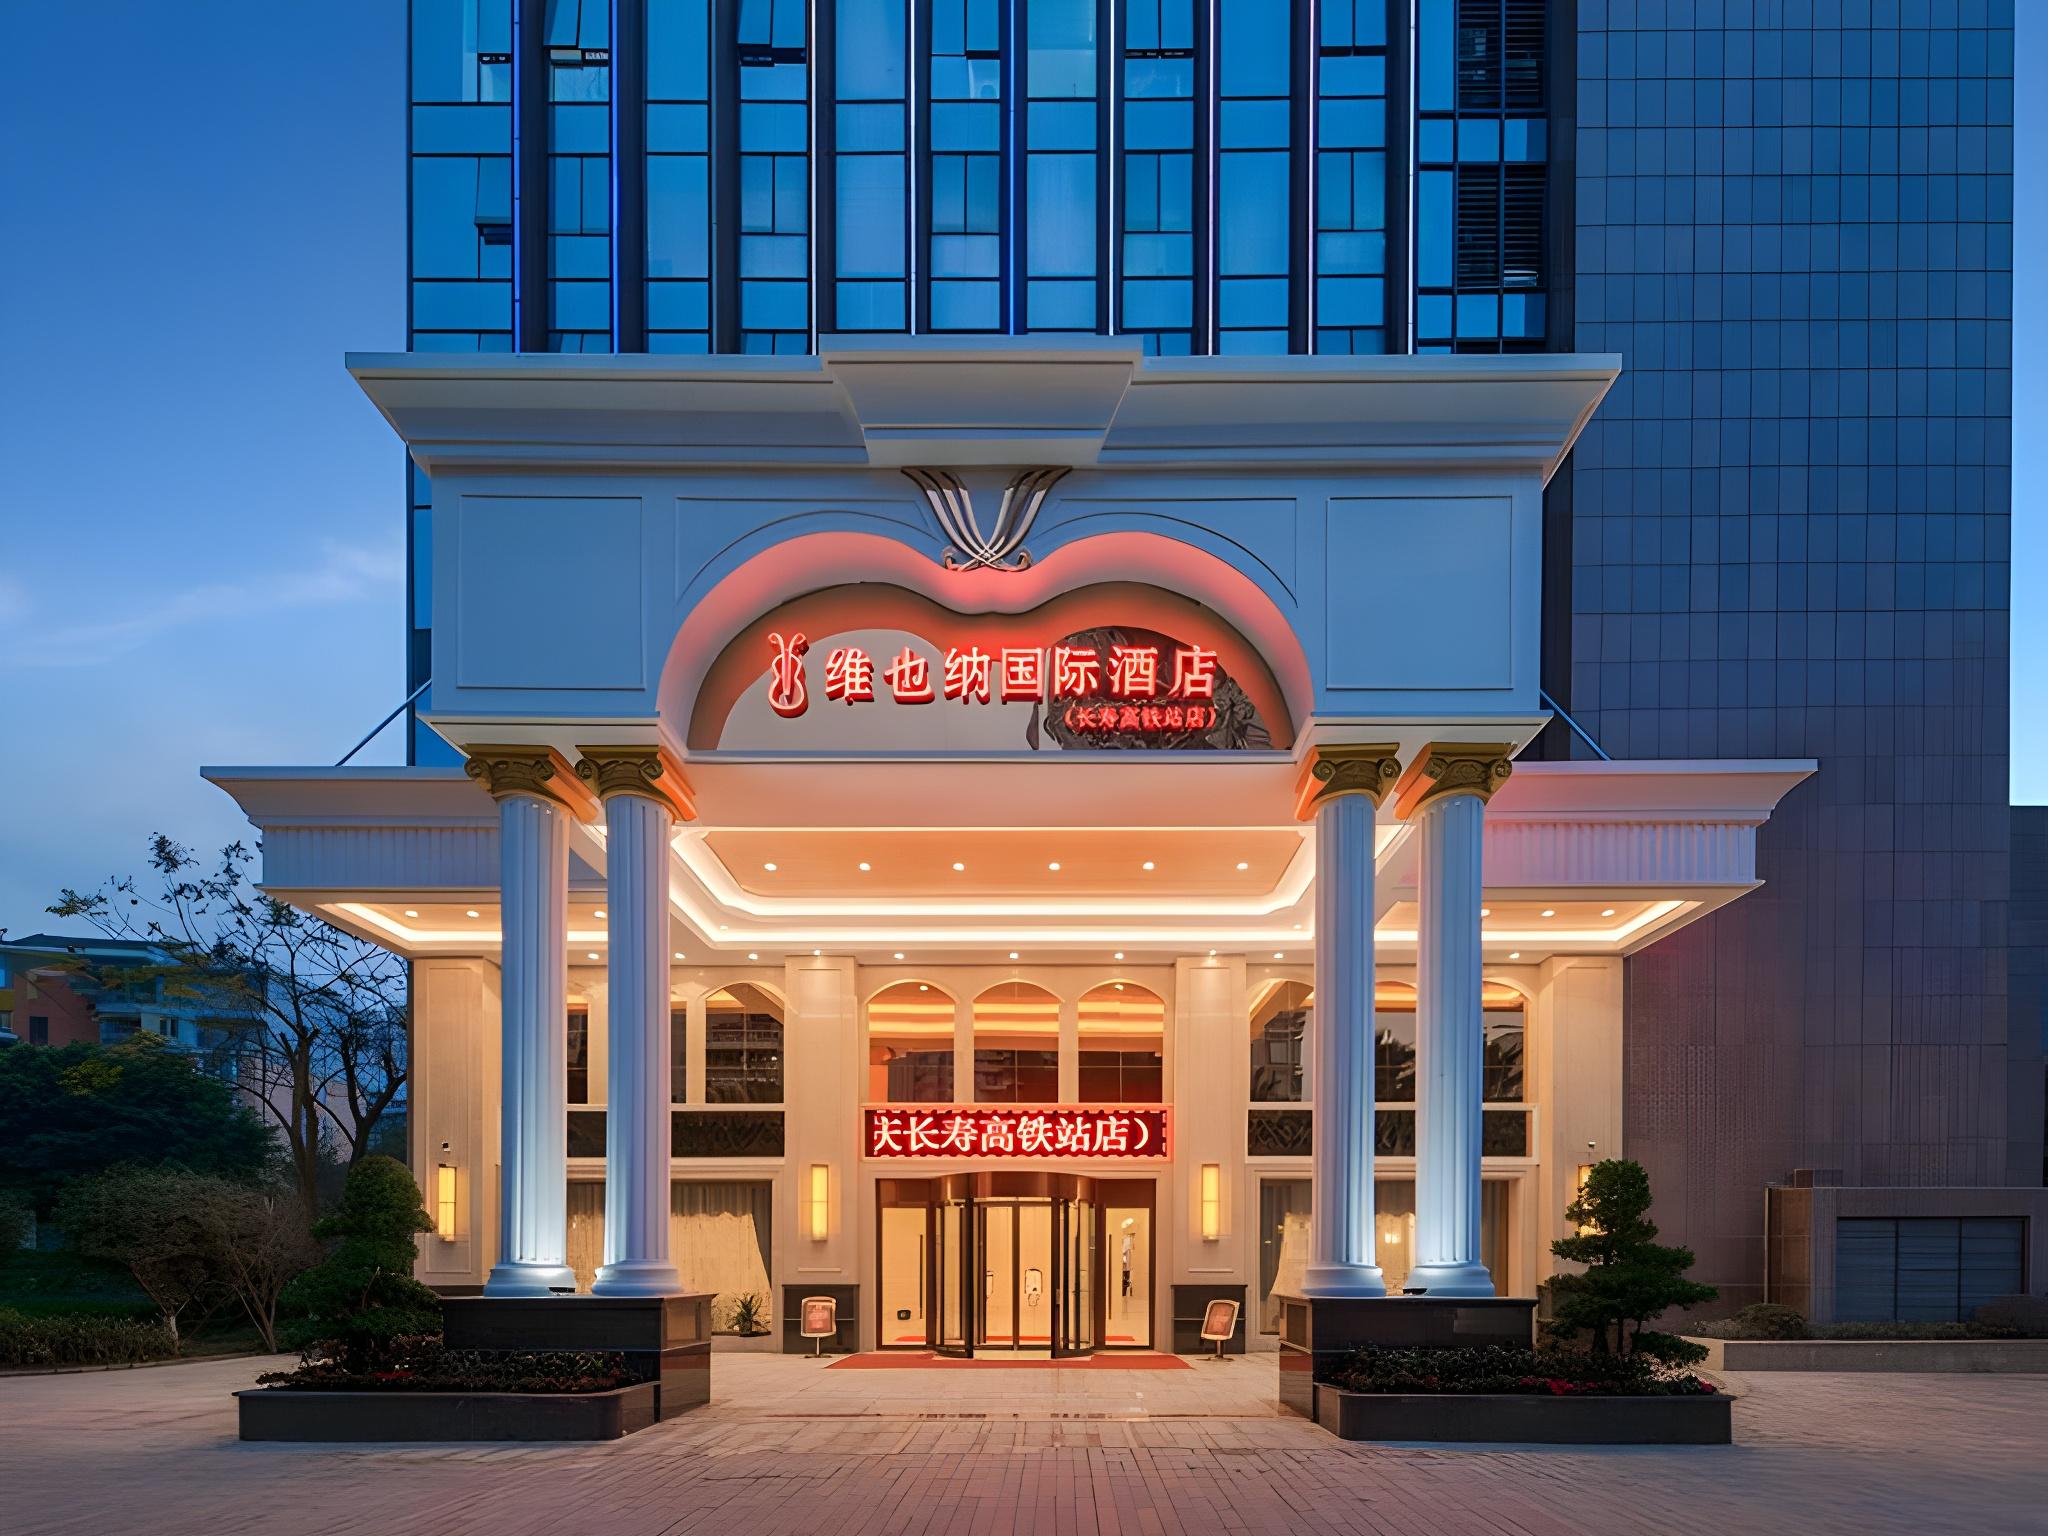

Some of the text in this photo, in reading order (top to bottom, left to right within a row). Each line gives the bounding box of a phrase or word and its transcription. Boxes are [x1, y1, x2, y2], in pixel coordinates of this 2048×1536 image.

[825, 645, 1217, 705] 维也纳国际酒店
